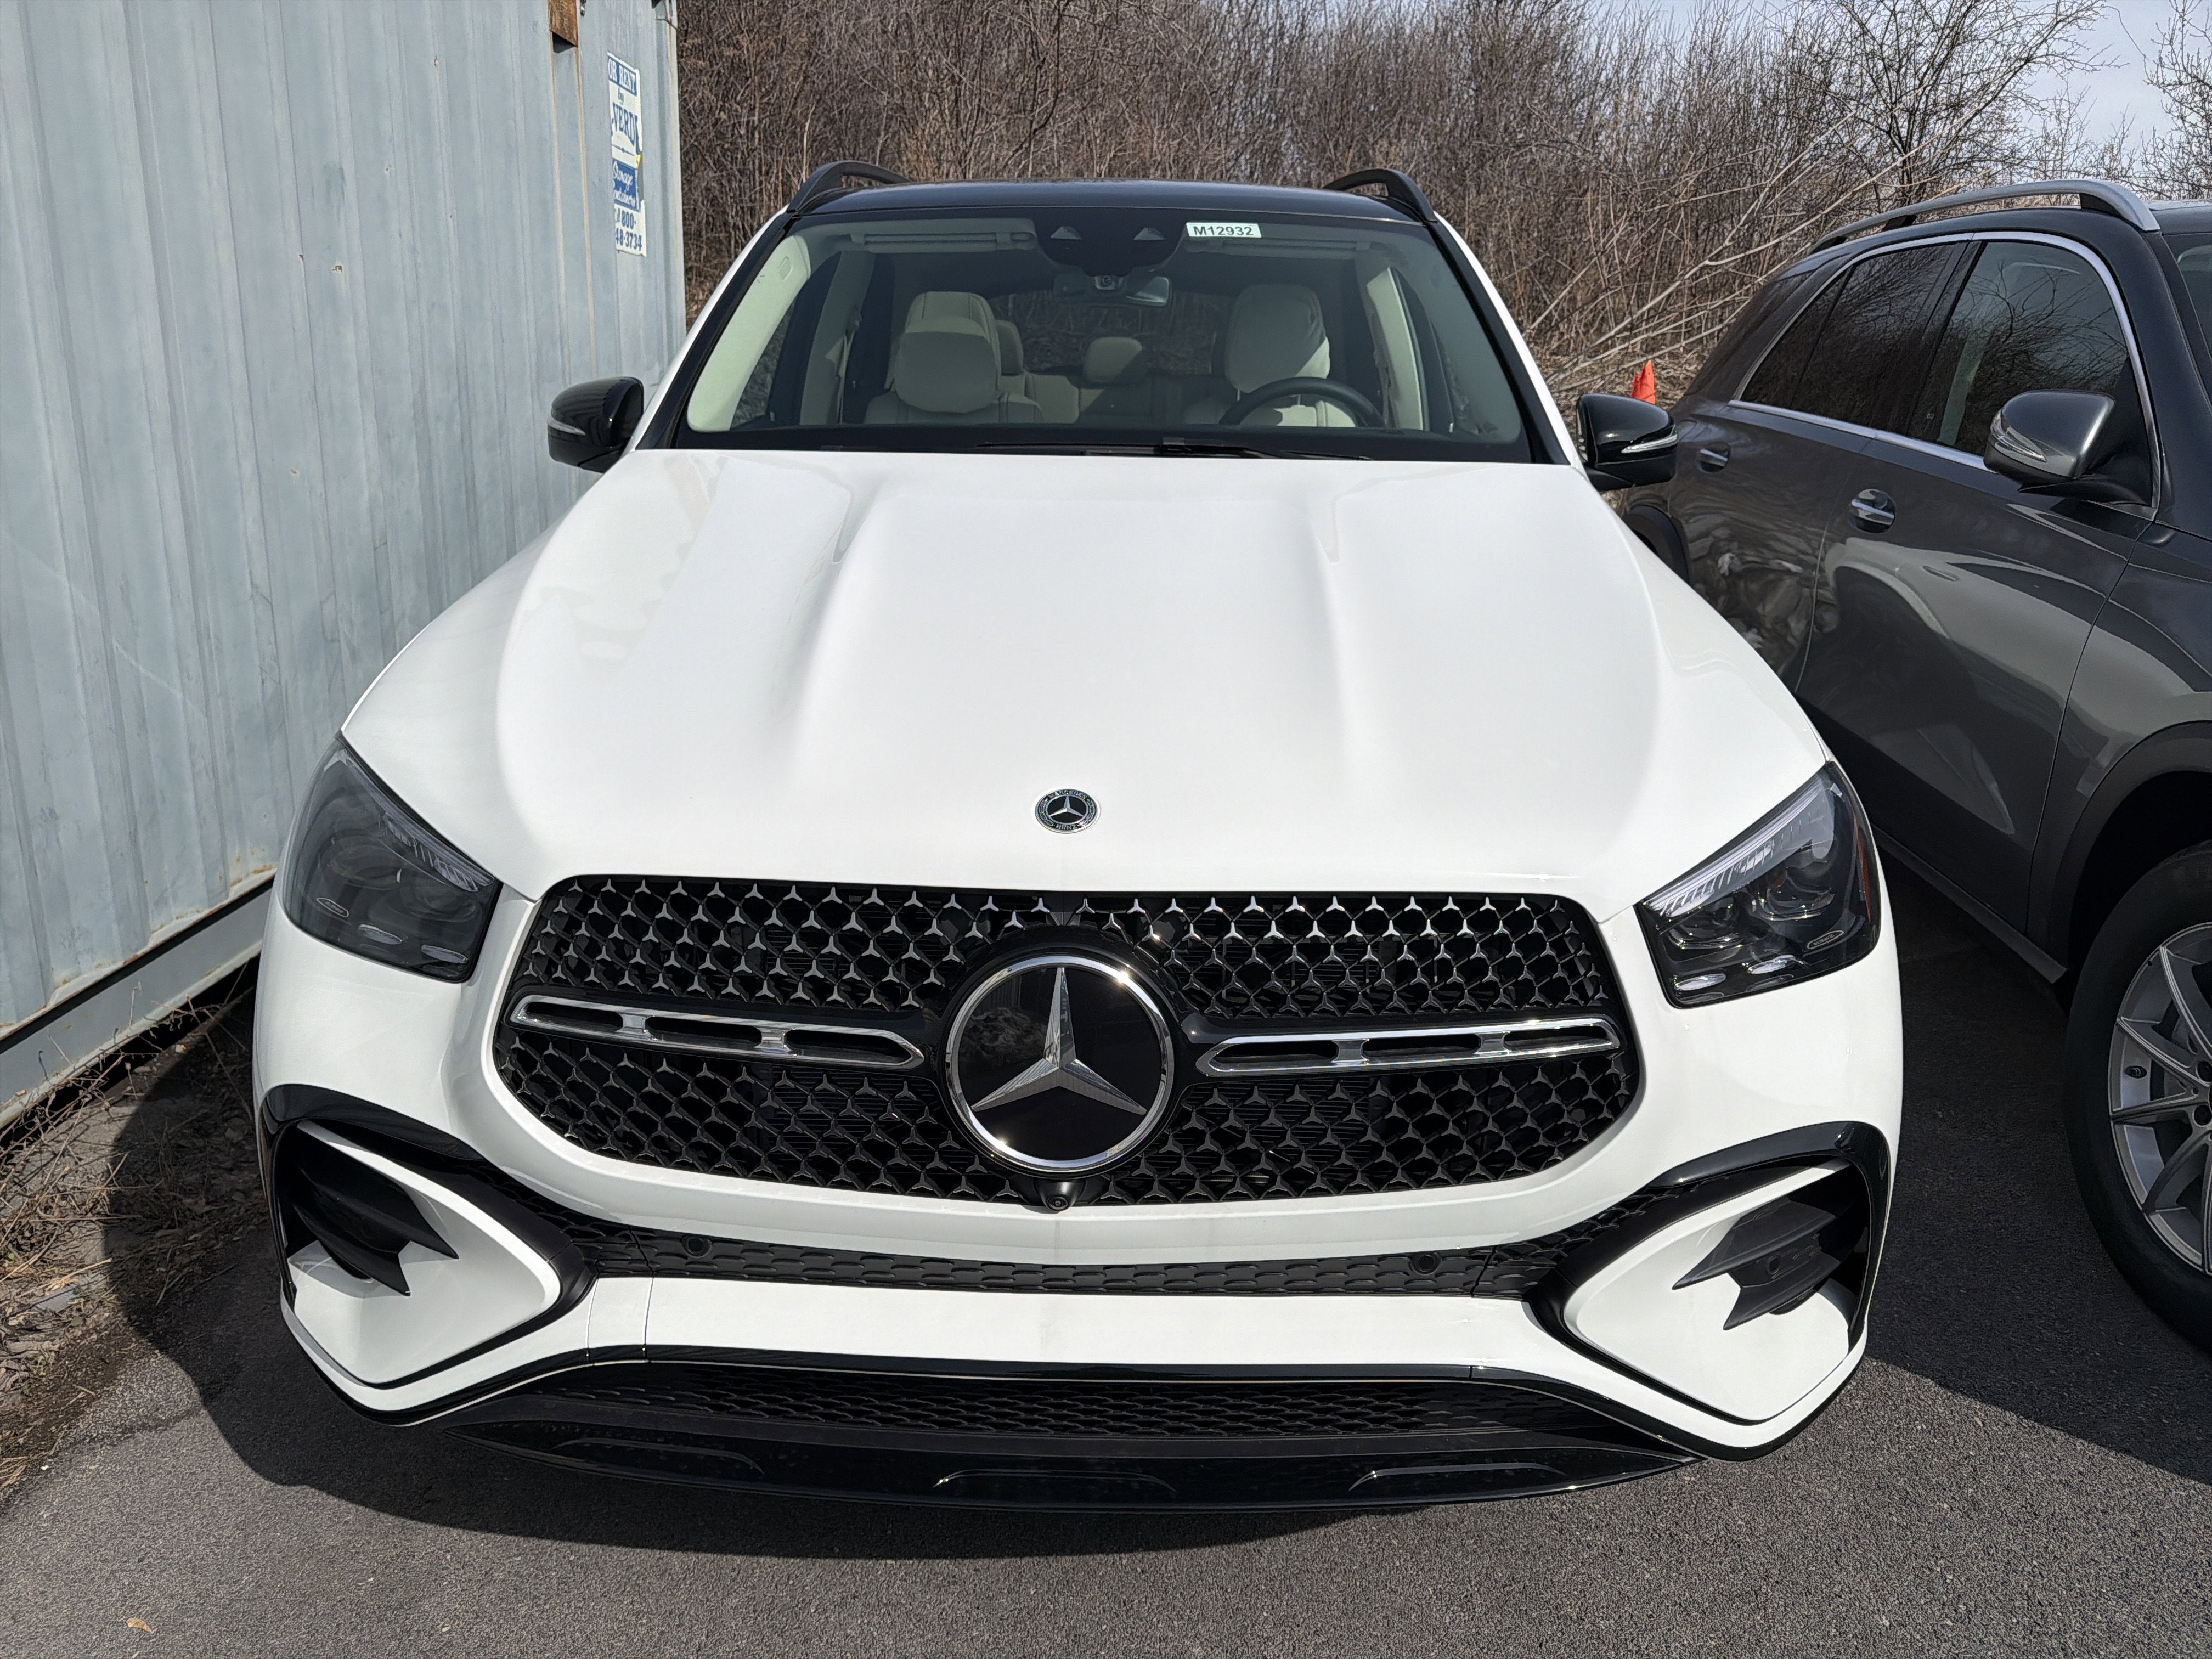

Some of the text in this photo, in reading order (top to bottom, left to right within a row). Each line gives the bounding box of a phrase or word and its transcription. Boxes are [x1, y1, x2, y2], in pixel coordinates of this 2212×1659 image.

[618, 64, 636, 93] RENT
[618, 87, 624, 105] by
[1193, 226, 1254, 236] M12932
